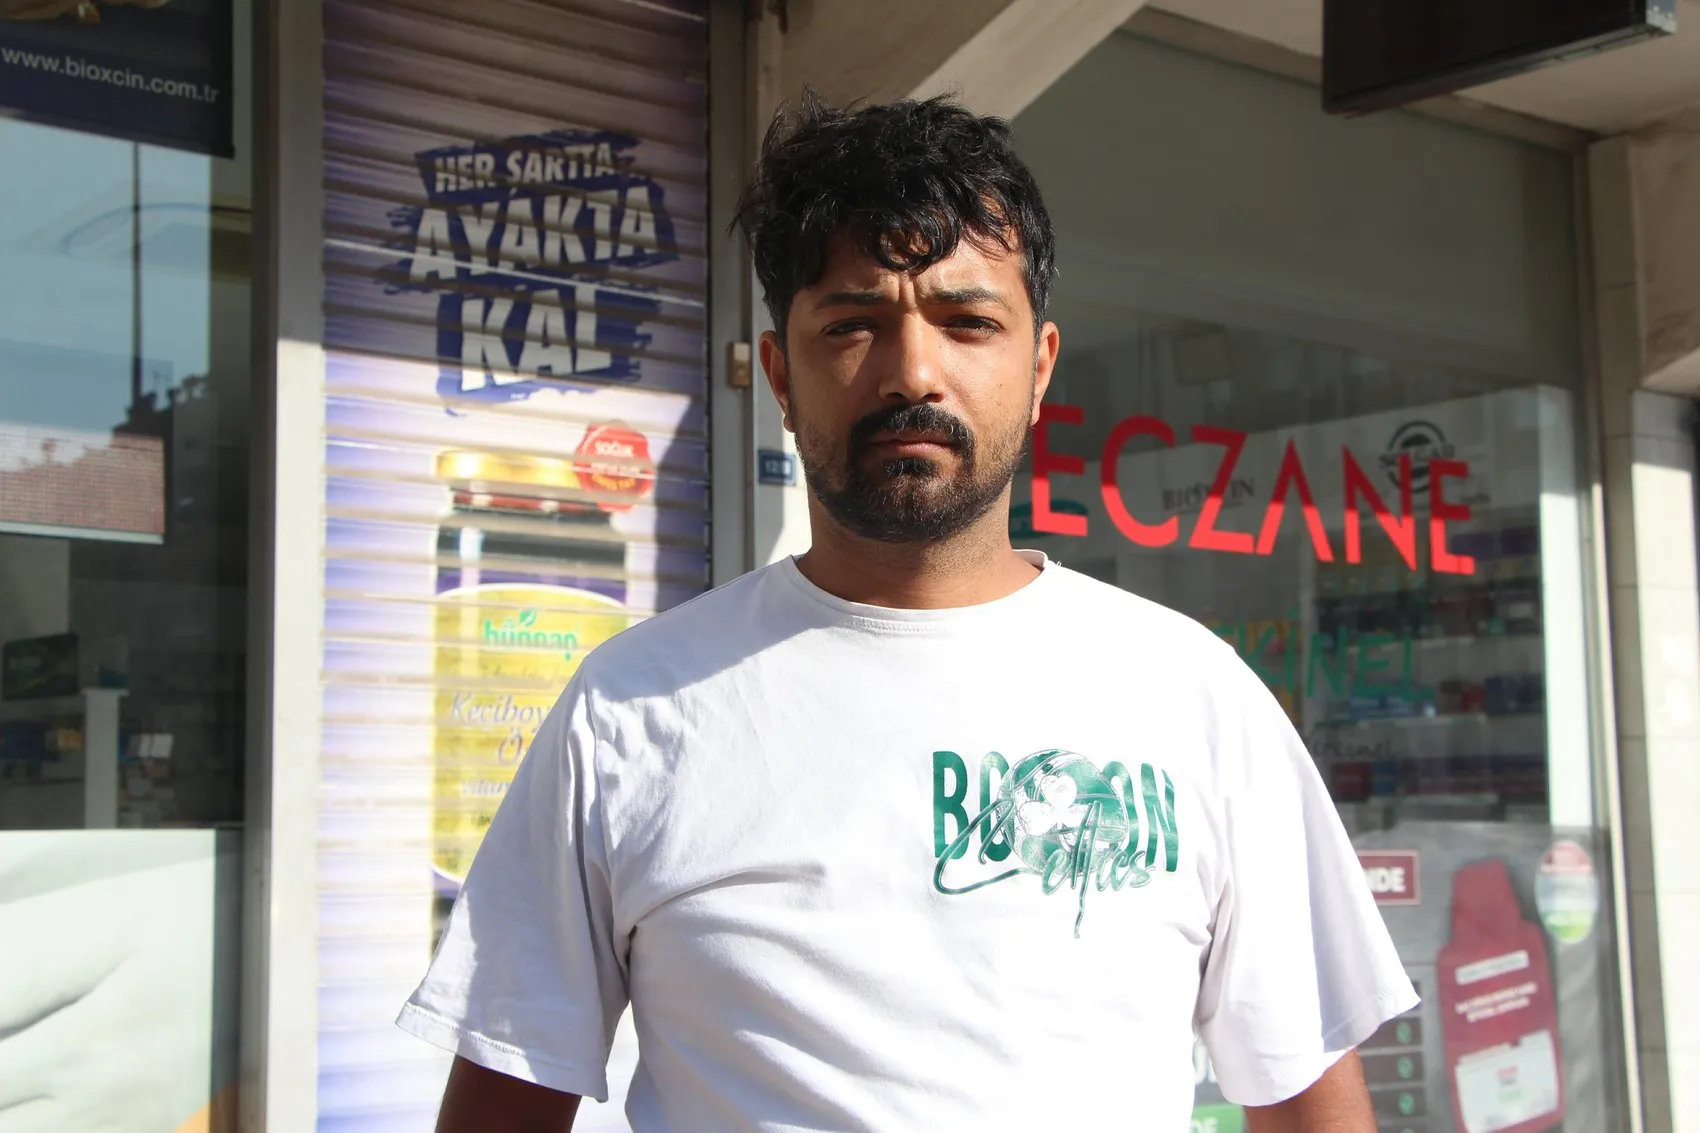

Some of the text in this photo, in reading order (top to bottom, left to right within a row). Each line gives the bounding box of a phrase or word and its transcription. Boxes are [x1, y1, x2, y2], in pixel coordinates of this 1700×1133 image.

[1, 47, 220, 103] www.bioxcin.com.tr
[434, 152, 496, 193] HER
[408, 186, 658, 284] AYAKTA
[459, 284, 612, 392] KAL
[1031, 402, 1476, 576] ECZANE
